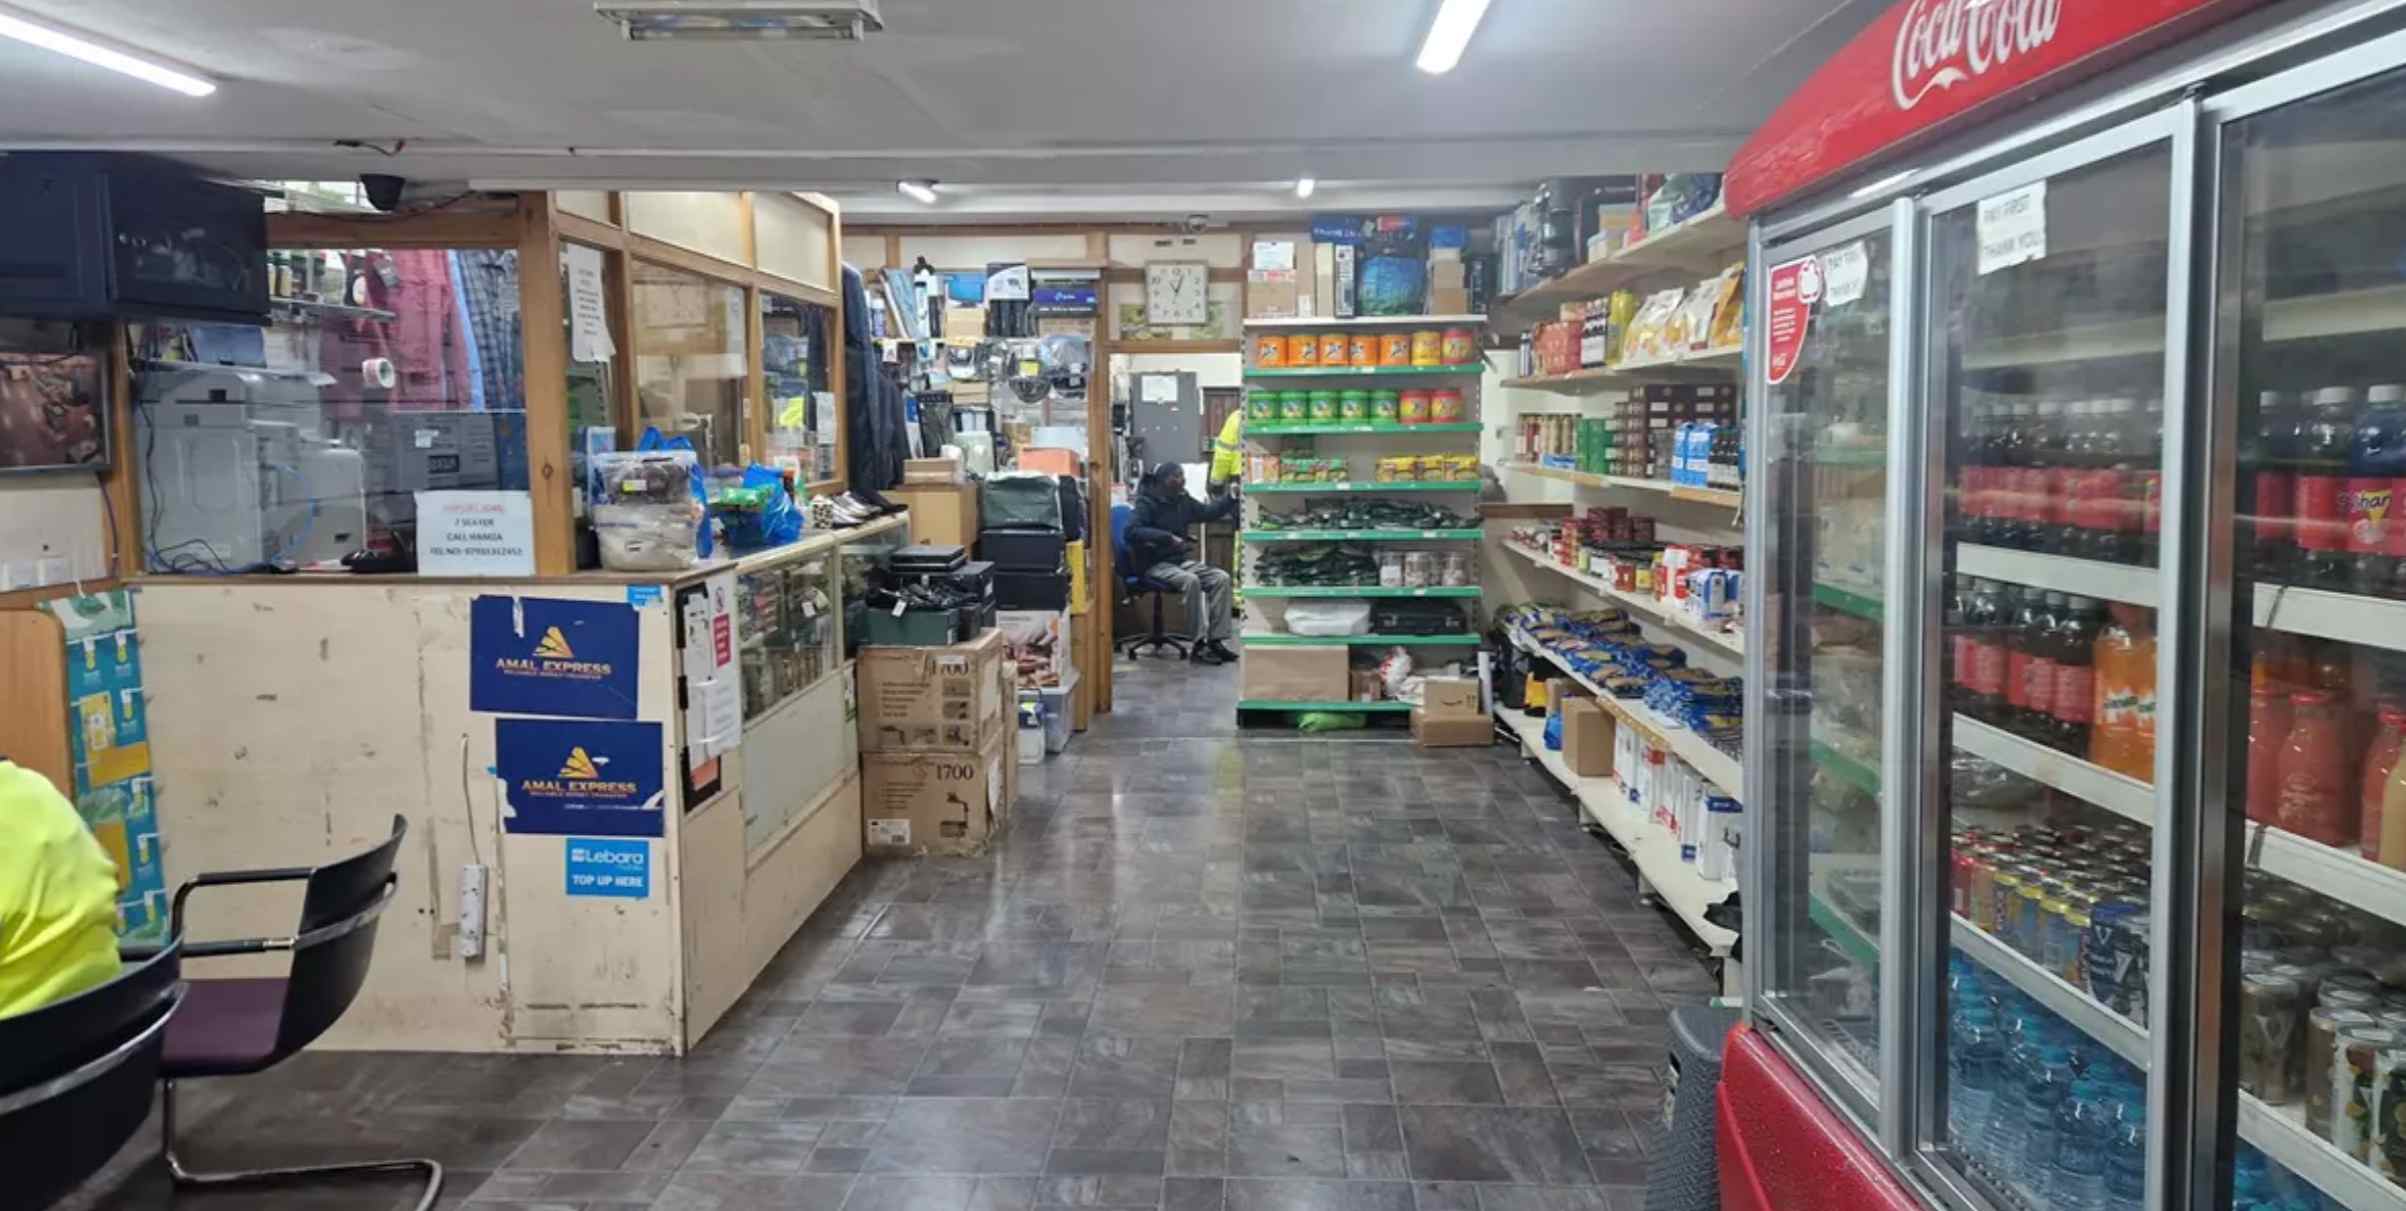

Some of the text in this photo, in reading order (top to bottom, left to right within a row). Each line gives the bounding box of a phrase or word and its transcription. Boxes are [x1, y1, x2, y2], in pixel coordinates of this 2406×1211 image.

[496, 658, 612, 676] AMAL EXPRESS
[936, 764, 974, 781] 1700
[521, 780, 637, 793] AMAL EXPRESS
[584, 848, 645, 864] Lebara
[573, 875, 644, 888] TOP UP HERE
